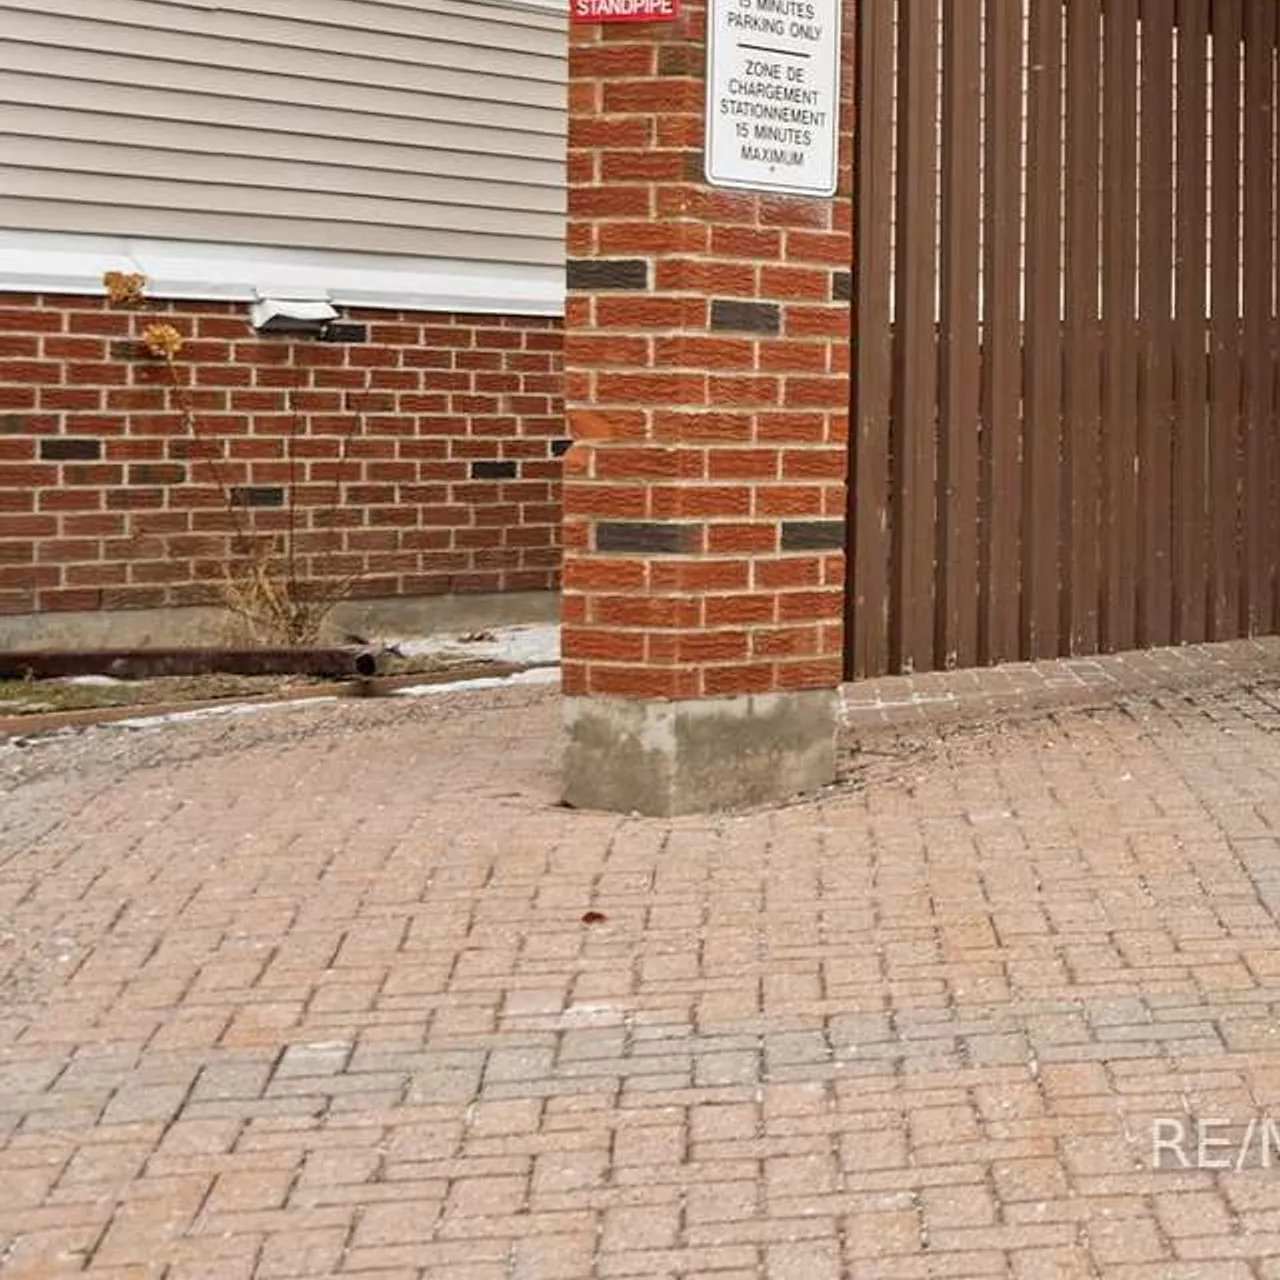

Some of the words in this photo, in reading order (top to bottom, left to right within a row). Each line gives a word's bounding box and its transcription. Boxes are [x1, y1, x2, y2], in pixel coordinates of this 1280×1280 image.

[728, 12, 785, 37] PARKING
[790, 20, 822, 41] ONLY
[745, 60, 781, 80] ZONE
[787, 67, 804, 83] DE
[729, 79, 818, 105] CHARGEMENT
[720, 99, 825, 127] STATIONNEMENT
[736, 123, 750, 137] 15
[754, 125, 811, 146] MINUTES
[740, 146, 805, 166] MAXIMUM
